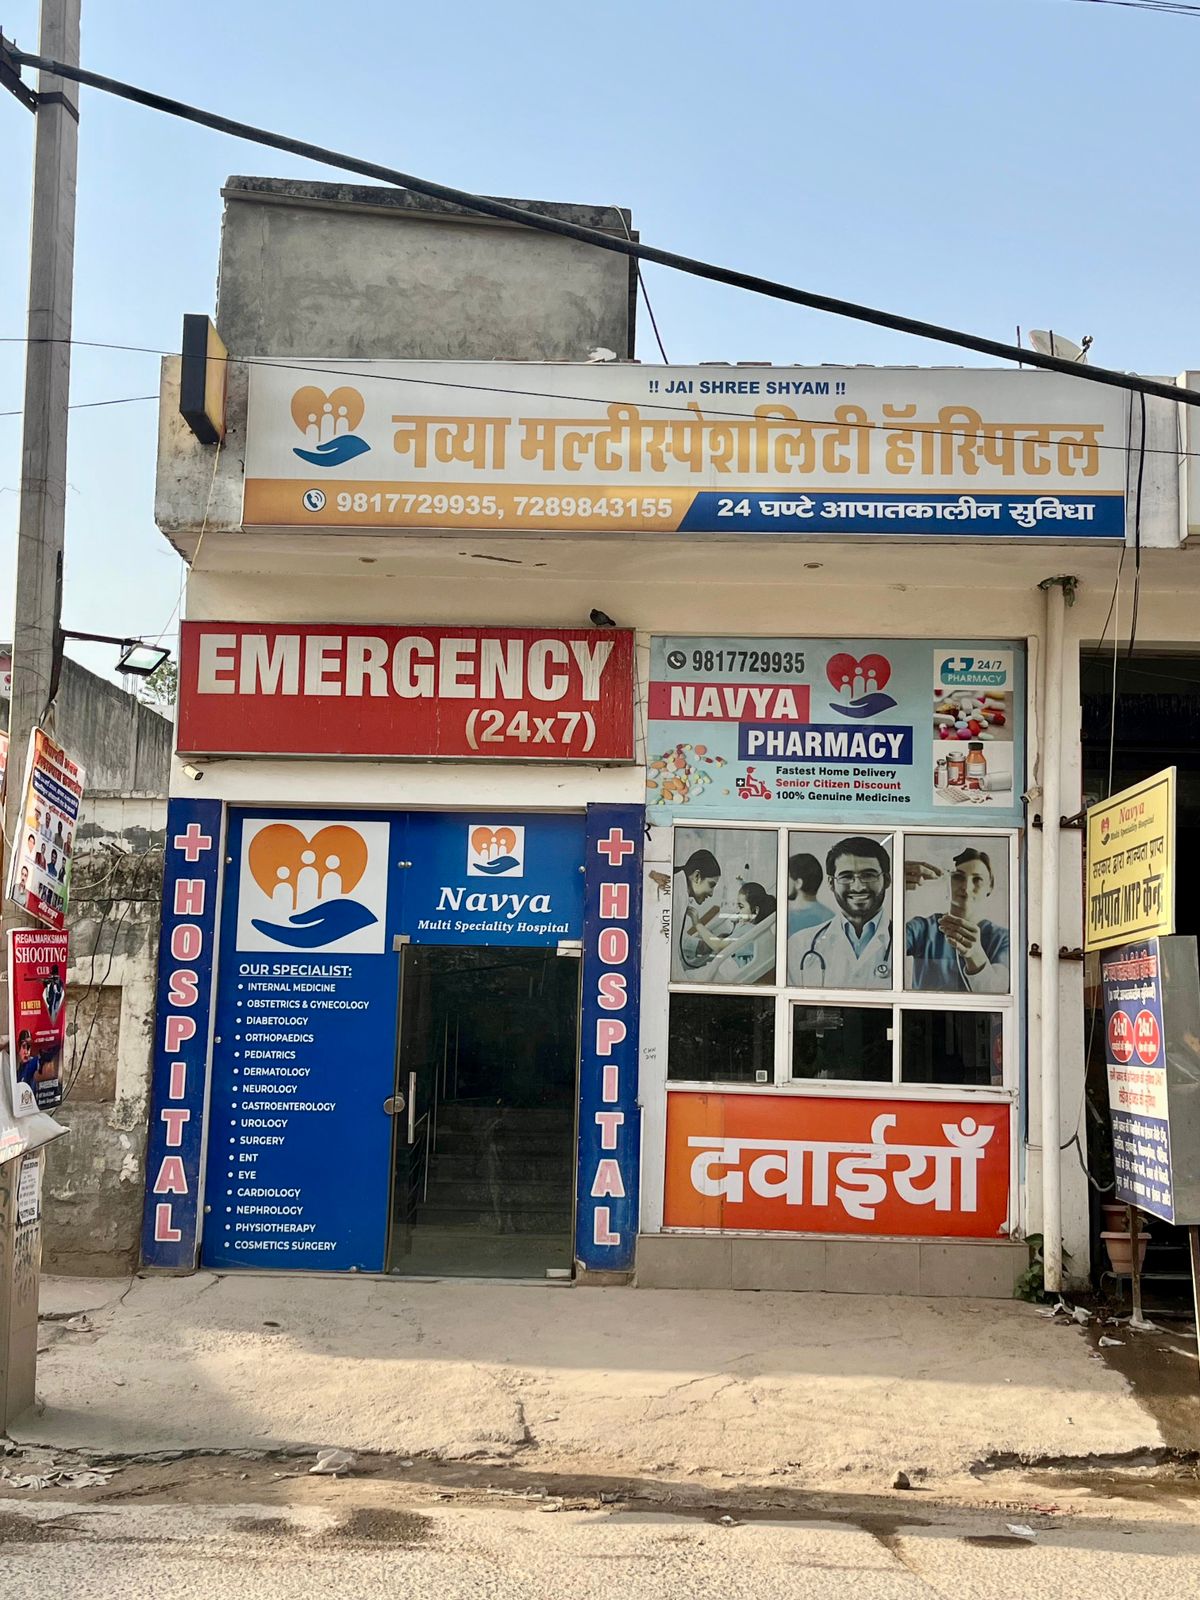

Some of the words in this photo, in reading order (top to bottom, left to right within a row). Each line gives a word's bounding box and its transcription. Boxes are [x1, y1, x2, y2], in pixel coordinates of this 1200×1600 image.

[649, 380, 659, 393] !!
[665, 380, 693, 394] JAI
[699, 380, 760, 394] SHREE
[766, 381, 830, 395] SHYAM
[836, 382, 846, 395] !!
[391, 414, 511, 470] नव्या
[881, 403, 1104, 477] हॉस्पिटल
[337, 492, 504, 520] 9817729935,
[514, 496, 672, 518] 7289843155
[718, 498, 751, 517] 24
[759, 495, 814, 519] घण्टे
[820, 495, 1000, 521] आपातकालीन
[1009, 497, 1095, 527] सुविधा
[197, 633, 614, 701] EMERGENCY
[692, 650, 805, 673] 9817729935
[977, 660, 1003, 670] 24/7
[947, 674, 1003, 683] PHARMACY
[670, 686, 799, 719] NAVYA
[465, 709, 597, 752] (24x7)
[747, 730, 905, 759] PHARMACY
[776, 766, 816, 775] Fastest
[819, 767, 850, 776] Home
[853, 768, 897, 779] Delivery
[776, 779, 811, 787] Senior
[814, 780, 850, 789] Citizen
[854, 781, 901, 790] Discount
[776, 791, 805, 800] 100%
[808, 791, 852, 801] Genuine
[856, 793, 911, 803] Medicines
[1119, 802, 1144, 824] Navya
[1092, 857, 1112, 880] सरकार
[436, 887, 552, 919] Navya
[418, 920, 451, 930] Multi
[454, 921, 514, 934] Speciality
[517, 922, 569, 933] Hospital
[15, 933, 67, 945] REGALMARKSMAN
[15, 947, 67, 963] SHOOTING
[239, 964, 269, 975] OUR
[273, 965, 352, 977] SPECIALIST:
[248, 983, 291, 992] INTERNAL
[293, 984, 336, 992] MEDICINE
[247, 1000, 300, 1009] OBSTETRICS
[302, 1001, 309, 1009] &
[310, 1001, 370, 1009] GYNECOLOGY
[246, 1016, 309, 1025] DIABETOLOGY
[245, 1034, 314, 1043] ORTHOPAEDICS
[153, 879, 205, 1242] HOSPITAL
[244, 1051, 296, 1059] PEDIATRICS
[590, 883, 630, 1246] HOSPITAL
[243, 1068, 310, 1077] DERMATOLOGY
[242, 1085, 298, 1093] NEUROLOGY
[241, 1102, 336, 1111] GASTROENTEROLOGY
[240, 1119, 288, 1128] UROLOGY
[239, 1136, 285, 1145] SURGERY
[239, 1153, 258, 1162] ENT
[238, 1171, 257, 1179] EYE
[237, 1188, 301, 1197] CARDIOLOGY
[236, 1206, 304, 1215] NEPHROLOGY
[235, 1223, 316, 1233] PHYSIOTHERAPY
[234, 1240, 290, 1250] COSMETICS
[291, 1242, 337, 1251] SURGERY
